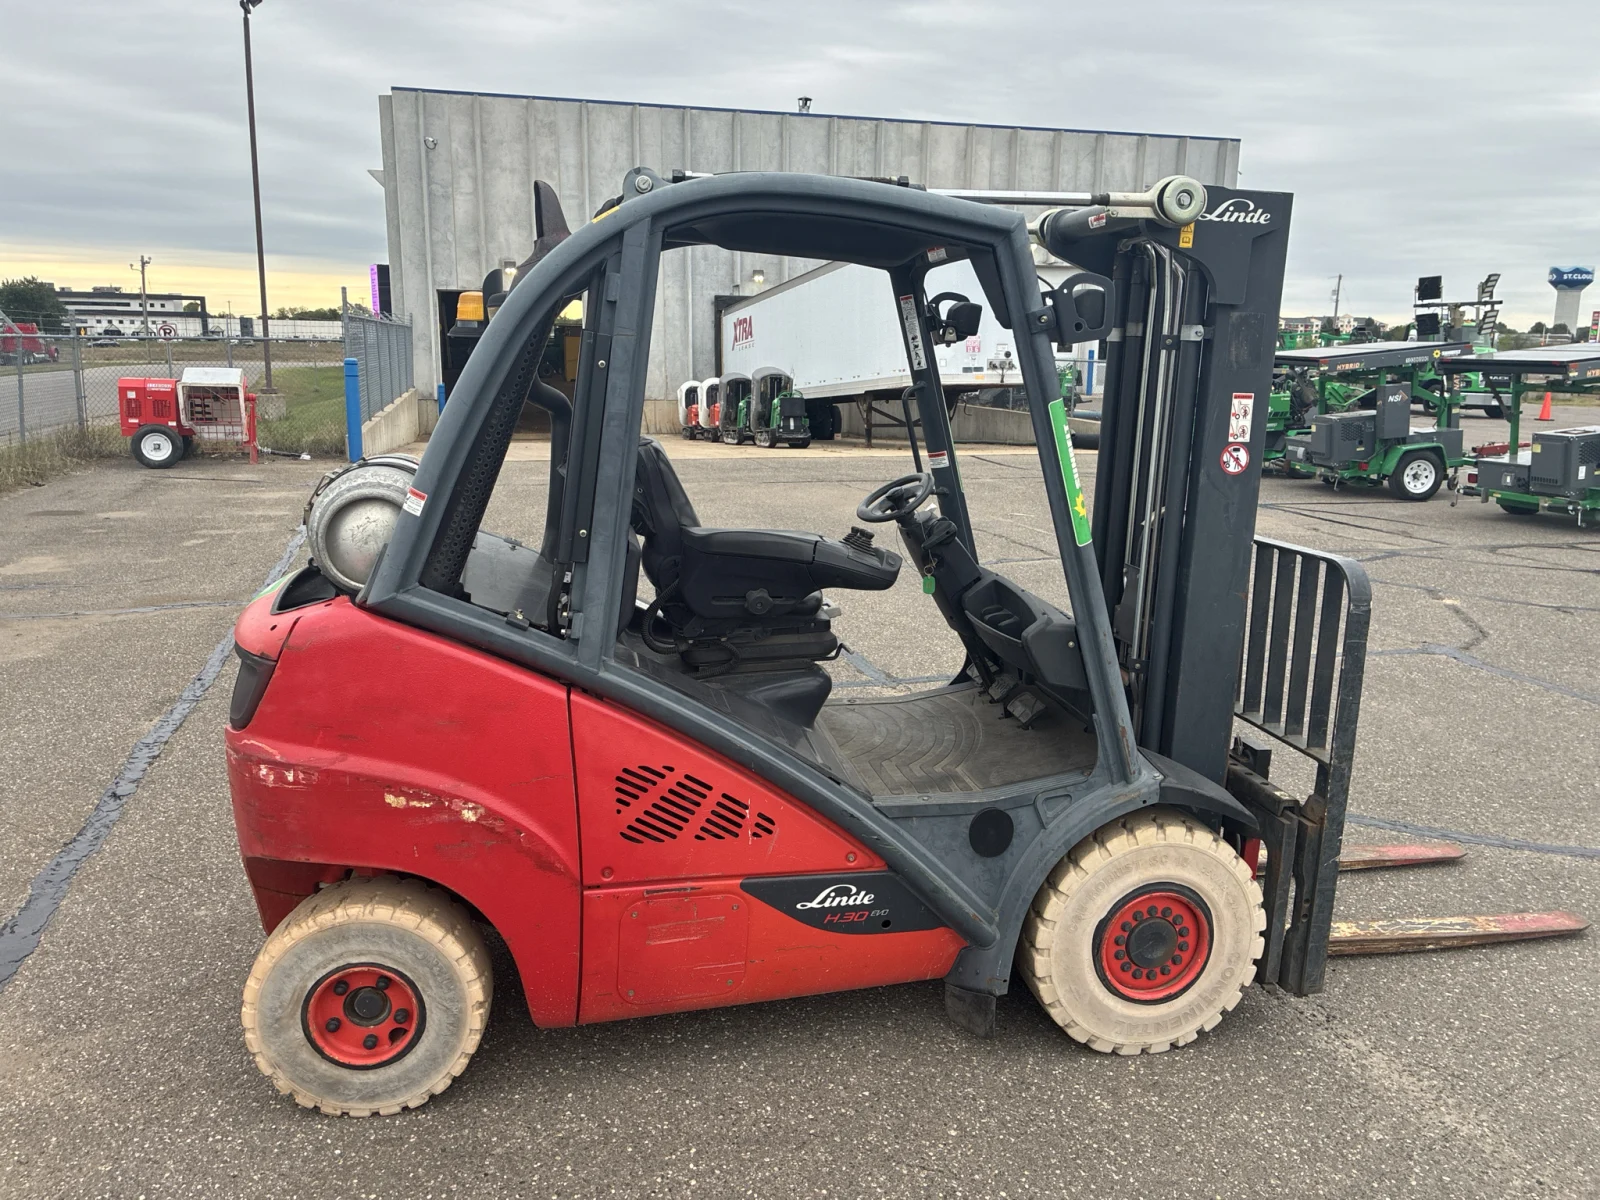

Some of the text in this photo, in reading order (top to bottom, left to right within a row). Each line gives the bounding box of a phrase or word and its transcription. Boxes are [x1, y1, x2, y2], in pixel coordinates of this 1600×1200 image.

[1199, 198, 1271, 225] Linde
[732, 315, 753, 351] XTRA
[738, 343, 755, 351] LEASE
[1387, 394, 1402, 403] NSI
[796, 884, 875, 910] Linde
[870, 908, 889, 917] EVO
